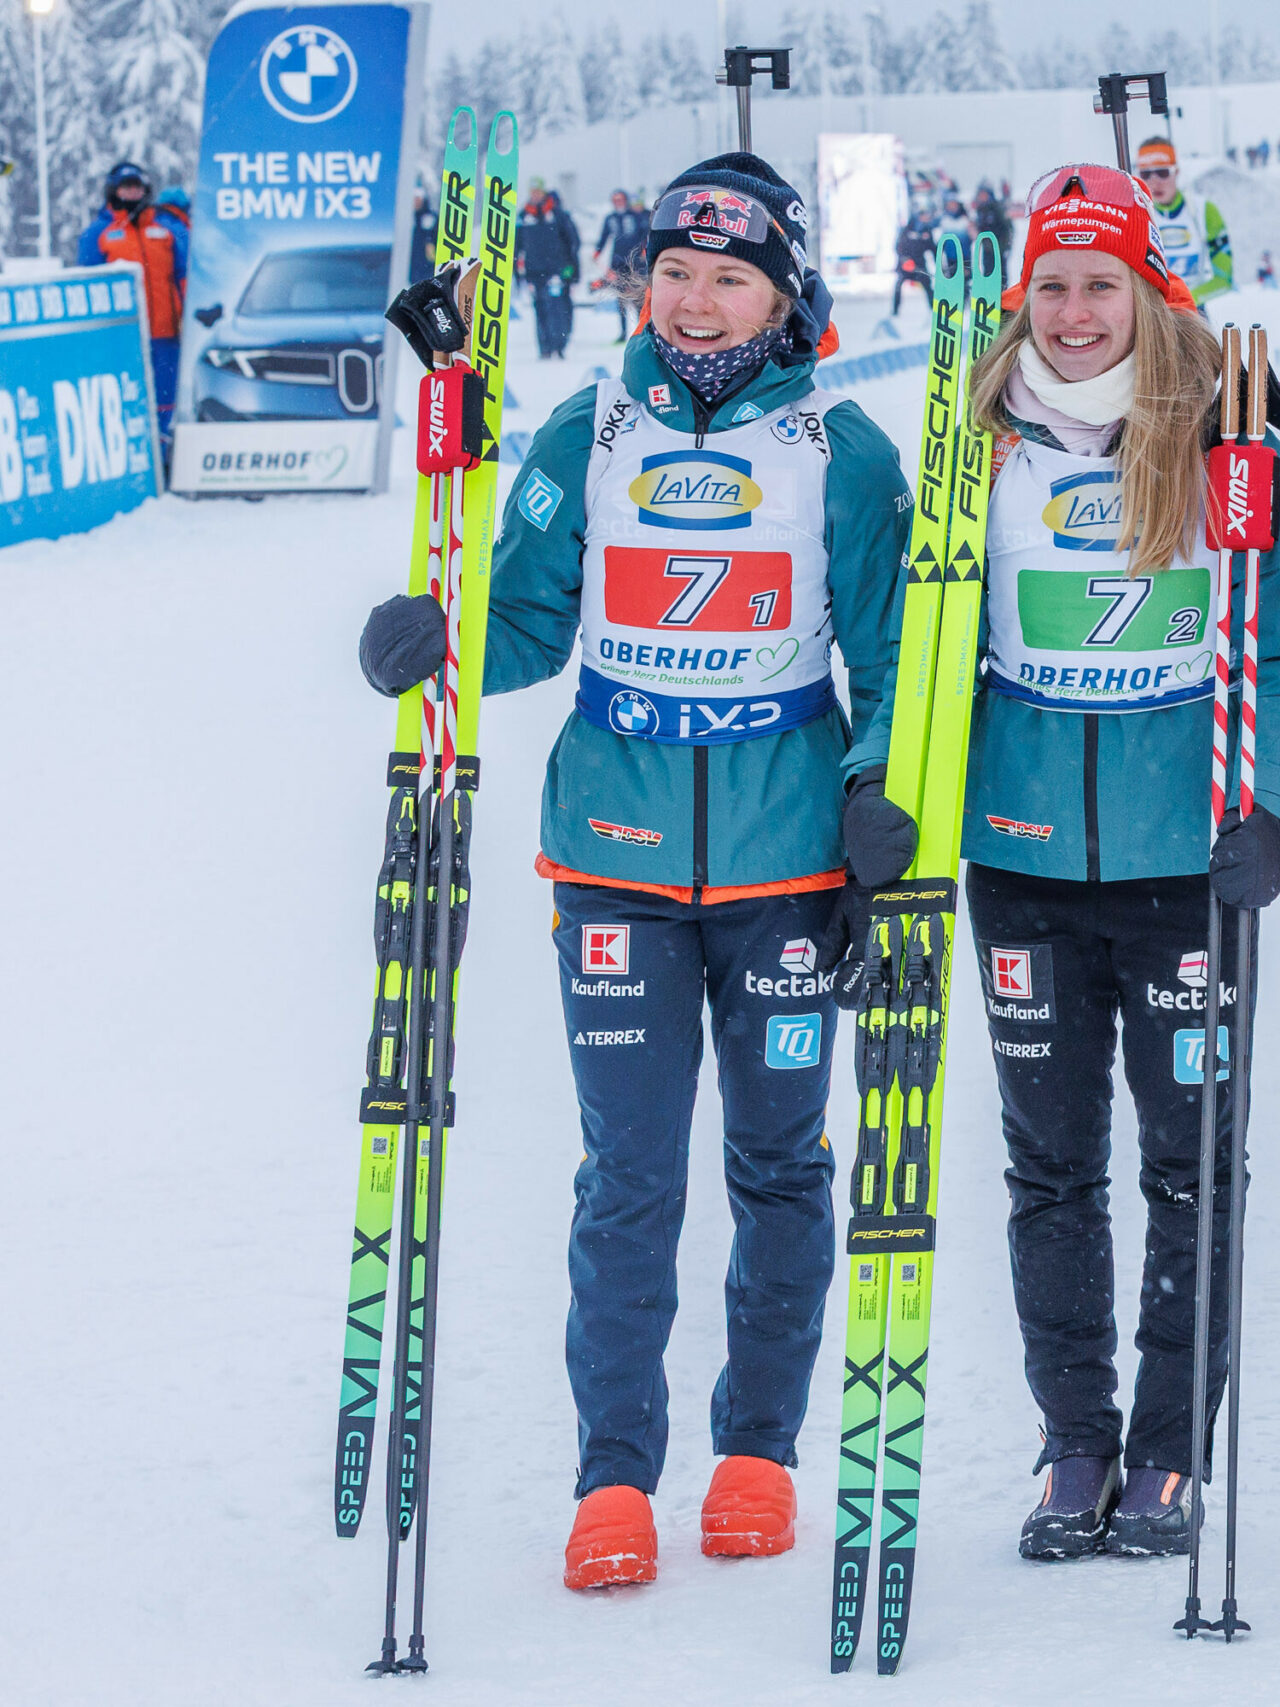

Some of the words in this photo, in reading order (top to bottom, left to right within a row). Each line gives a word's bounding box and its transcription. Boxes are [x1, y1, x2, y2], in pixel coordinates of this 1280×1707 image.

[213, 152, 287, 184] THE
[297, 151, 382, 183] NEW
[216, 189, 303, 220] BMW
[314, 188, 371, 219] iX3
[1044, 198, 1128, 222] VIESSMANN
[1042, 217, 1122, 236] Wärmepumpen
[474, 175, 513, 404] FISCHER
[921, 298, 959, 524] FISCHER
[53, 373, 128, 489] DKB
[202, 451, 312, 471] OBERHOF
[657, 556, 733, 627] 7
[748, 590, 780, 627] 1
[1082, 577, 1153, 647] 7
[1165, 607, 1201, 645] 2
[600, 638, 751, 671] OBERHOF
[632, 668, 657, 682] Herz
[659, 673, 744, 686] Deutschlands
[1019, 662, 1173, 691] OBERHOF
[872, 890, 947, 902] FISCHER
[571, 979, 645, 998] Kaufland
[745, 971, 838, 998] tectak
[988, 1002, 1050, 1020] Kaufland
[585, 1029, 646, 1046] TERREX
[777, 1022, 815, 1061] TQ
[1001, 1042, 1052, 1058] TERREX
[851, 1228, 926, 1240] FISCHER
[339, 1431, 365, 1525] SPEED
[835, 1561, 859, 1656] SPEED
[881, 1562, 904, 1659] SPEED
